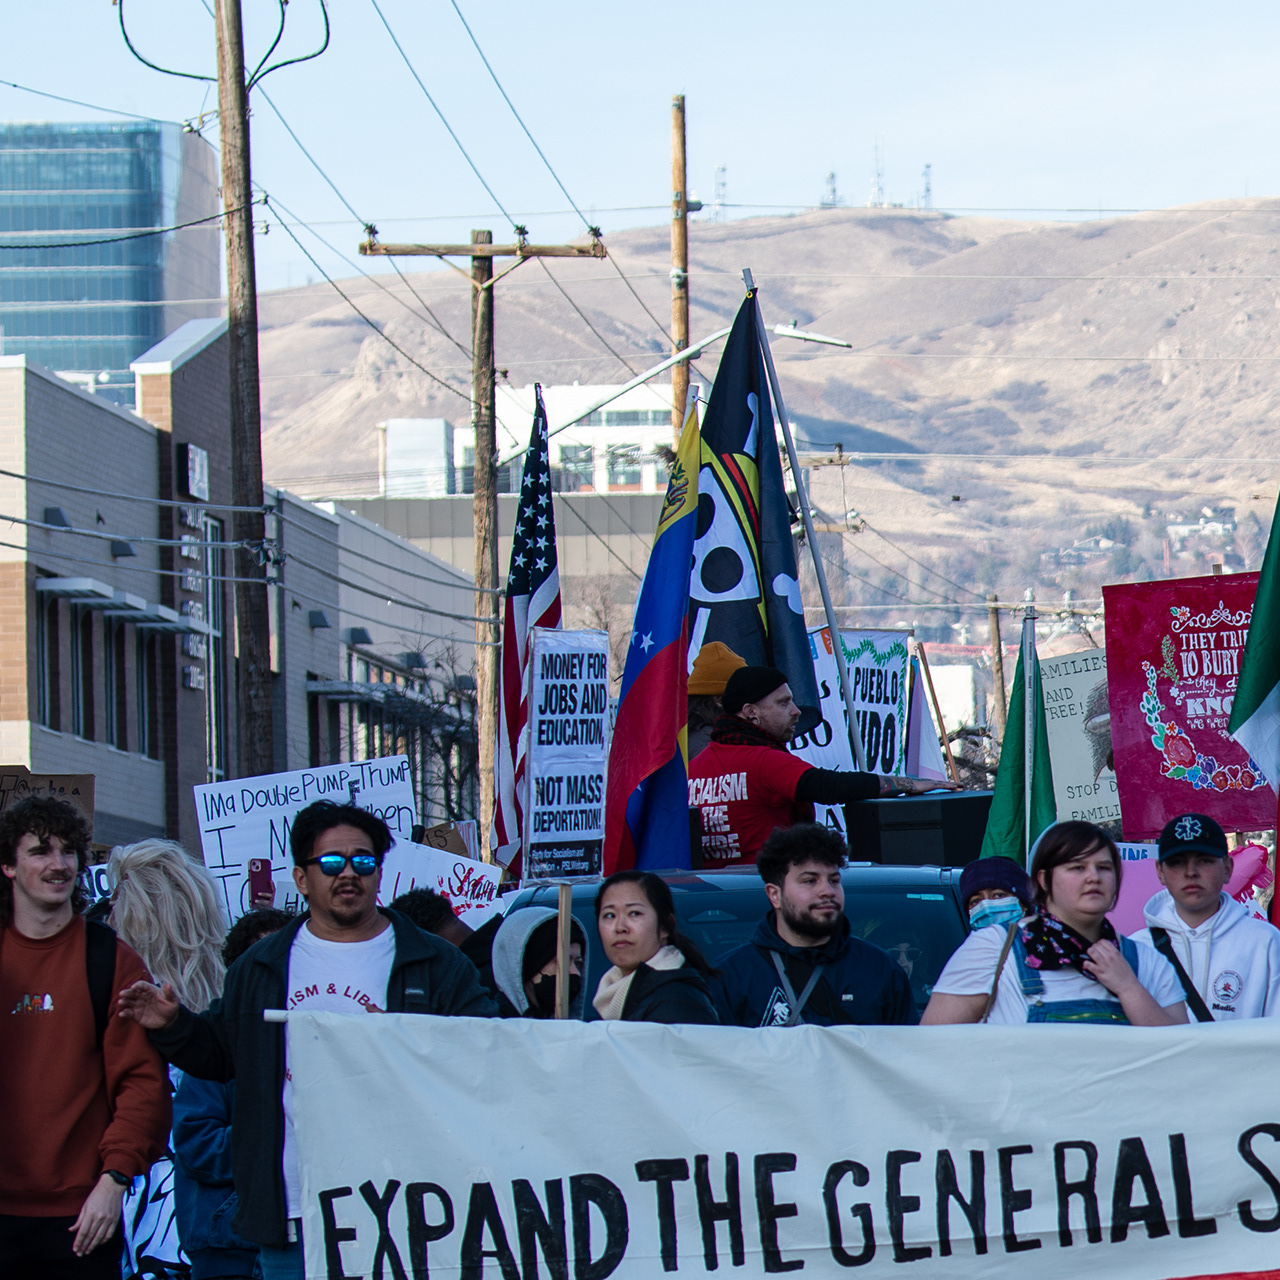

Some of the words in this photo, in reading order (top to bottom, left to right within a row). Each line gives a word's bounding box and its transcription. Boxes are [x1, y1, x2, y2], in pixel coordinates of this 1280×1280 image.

[1180, 632, 1216, 650] THEY
[541, 653, 585, 680] MONEY
[587, 653, 607, 680] FOR
[1040, 656, 1108, 680] AMILIES
[1201, 649, 1239, 676] BURY
[538, 683, 578, 715] JOBS
[580, 683, 607, 715] AND
[853, 667, 899, 706] PUEBLO
[1046, 687, 1074, 704] AND
[1195, 676, 1217, 697] they
[1186, 696, 1235, 717] KNO
[537, 718, 605, 750] EDUCATION,
[1207, 717, 1228, 730] wer
[534, 776, 563, 806] NOT
[566, 774, 603, 805] MASS
[688, 772, 748, 806] OCIALISM
[1067, 783, 1100, 799] STOP
[533, 808, 602, 833] DEPORTATION!
[702, 805, 730, 833] THE
[1072, 804, 1122, 822] FAMILI
[701, 833, 742, 860] TURE
[326, 983, 338, 995] &
[1212, 1003, 1236, 1013] Medic
[634, 1151, 805, 1273] THE
[822, 1133, 1218, 1267] GENERAL
